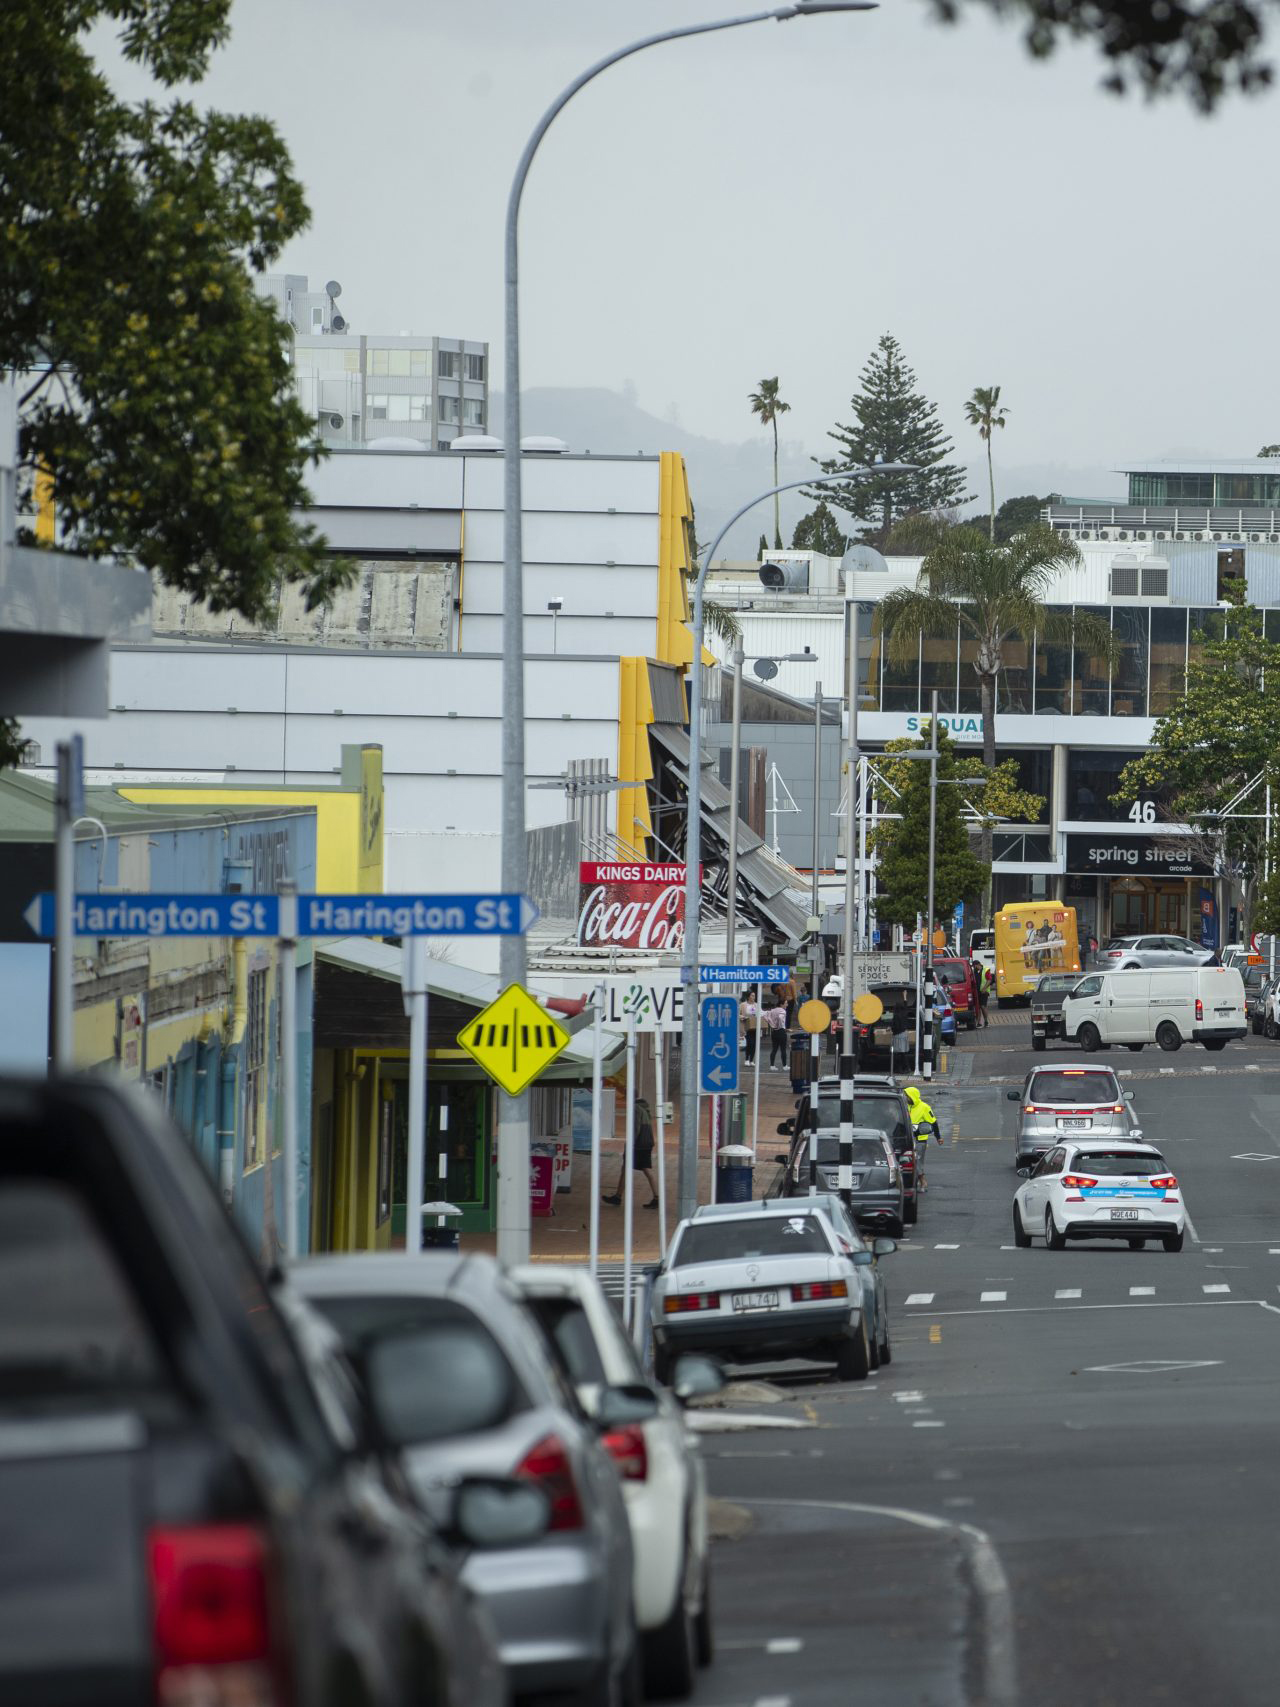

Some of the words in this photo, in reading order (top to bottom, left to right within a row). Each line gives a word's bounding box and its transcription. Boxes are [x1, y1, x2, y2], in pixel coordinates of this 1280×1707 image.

[1128, 800, 1156, 824] 46
[1088, 845, 1139, 865] spring
[1144, 845, 1192, 862] street
[596, 866, 641, 881] KINGS
[644, 866, 686, 881] DAIRY
[1169, 864, 1192, 872] arcade
[229, 900, 267, 930] St
[310, 900, 465, 933] Harington
[474, 899, 511, 930] St
[577, 885, 686, 949] Coca-Co
[709, 968, 764, 980] Hamilton
[767, 968, 781, 980] St
[858, 965, 892, 973] SERVICE
